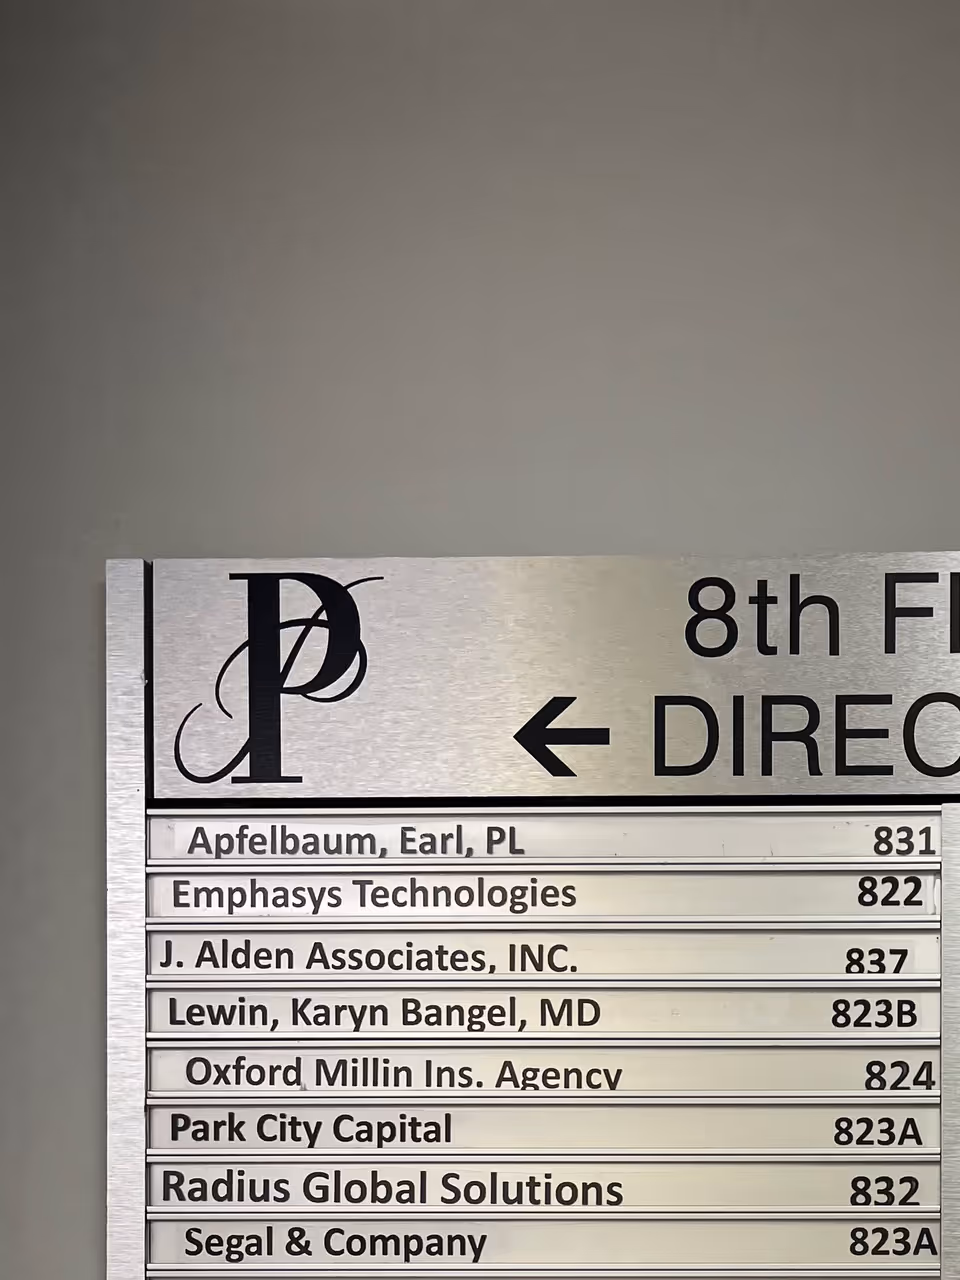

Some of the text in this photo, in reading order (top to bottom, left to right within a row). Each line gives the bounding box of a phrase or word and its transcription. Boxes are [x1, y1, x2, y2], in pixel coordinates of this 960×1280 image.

[685, 574, 839, 657] 8th
[188, 825, 935, 857] Apfelbaum, Earl, PL 831
[174, 876, 922, 914] Emphasys Technologies 822
[160, 939, 908, 974] J. Alden Associates, INC. 837
[170, 997, 917, 1032] Lewin, Karyn Bangel, MD 823B
[186, 1056, 301, 1086] Oxford
[316, 1058, 411, 1087] Millin
[426, 1060, 482, 1087] Ins.
[865, 1061, 935, 1090] 824
[172, 1112, 922, 1148] Park City Capital 823A
[163, 1169, 920, 1206] Radius Global Solutions 832
[185, 1226, 938, 1263] Segal & Company 823A
